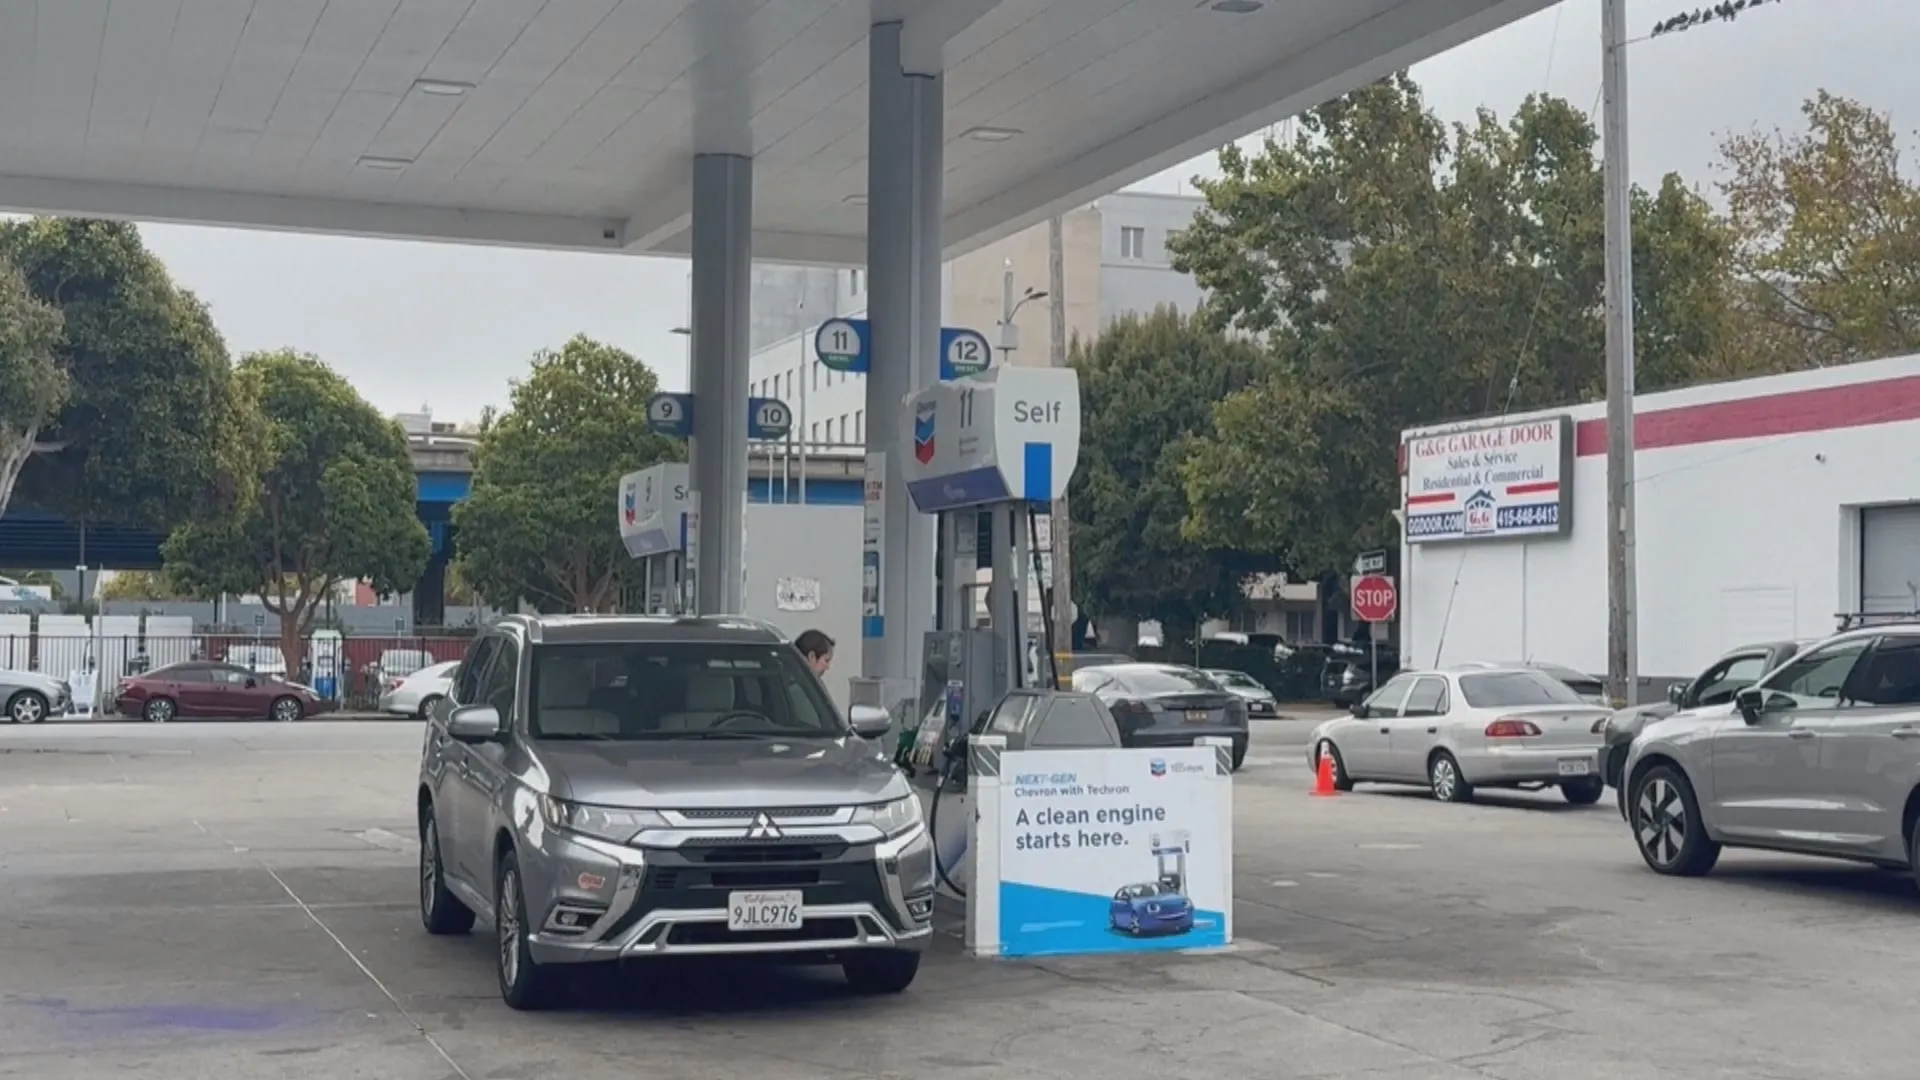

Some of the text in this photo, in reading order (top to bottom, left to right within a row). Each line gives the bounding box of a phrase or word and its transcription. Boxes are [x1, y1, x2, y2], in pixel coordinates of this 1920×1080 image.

[832, 330, 848, 350] 11
[955, 340, 979, 361] 12
[661, 402, 674, 418] 9
[763, 408, 782, 424] 10
[959, 387, 975, 429] 11
[1014, 399, 1063, 424] Self
[1416, 423, 1554, 458] G&G GARAGE DOOR
[1447, 451, 1519, 469] Sales & Service
[1422, 464, 1543, 491] Residential & Commercial
[674, 484, 688, 501] S
[1356, 588, 1393, 607] STOP
[1015, 773, 1077, 786] NEXT-GEN
[1014, 784, 1130, 798] Chevron with Techron
[1016, 803, 1166, 826] A clean engine
[1016, 829, 1130, 850] starts here.
[734, 904, 798, 925] 9JLC976
